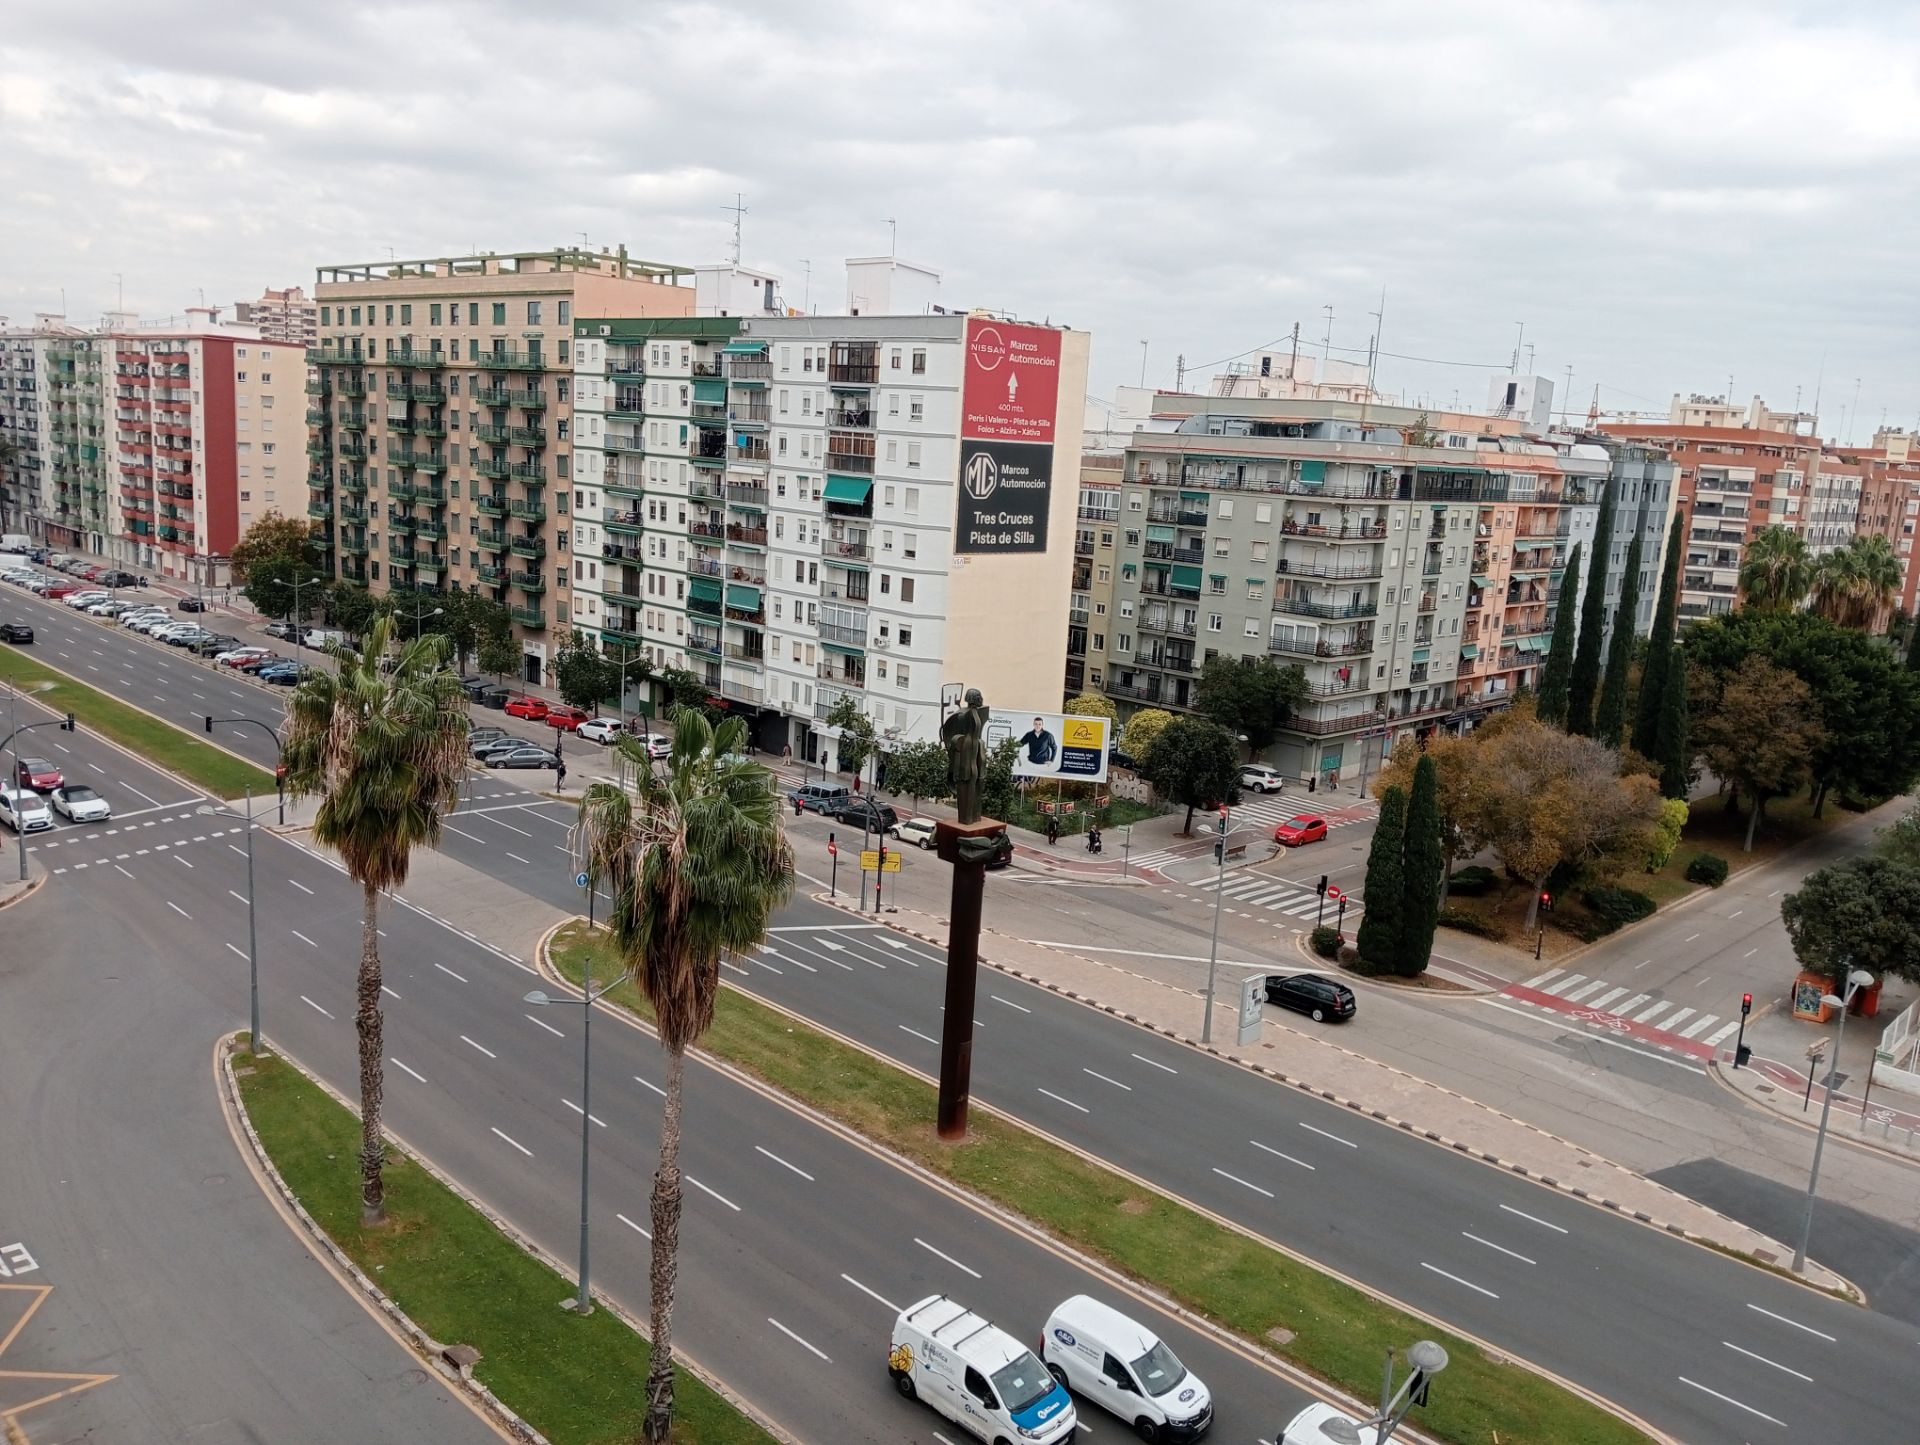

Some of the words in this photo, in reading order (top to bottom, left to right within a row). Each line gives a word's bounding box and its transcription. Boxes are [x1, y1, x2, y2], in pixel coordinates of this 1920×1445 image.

[971, 343, 1006, 354] NISSAN
[1010, 340, 1038, 352] Marcos
[1008, 353, 1056, 367] Automoción
[998, 403, 1011, 412] 400
[968, 414, 985, 423] Peris
[988, 416, 1009, 425] Valero
[1013, 418, 1029, 427] Pista
[1029, 419, 1037, 427] de
[1037, 419, 1051, 428] Silla
[999, 426, 1017, 435] Alzira
[968, 456, 995, 495] MG
[1001, 464, 1030, 475] Marcos
[1000, 478, 1046, 489] Automoción
[973, 511, 997, 525] Tres
[998, 511, 1034, 525] Cruces
[970, 531, 997, 545] Pista
[998, 531, 1012, 544] de
[1013, 531, 1035, 544] Silla
